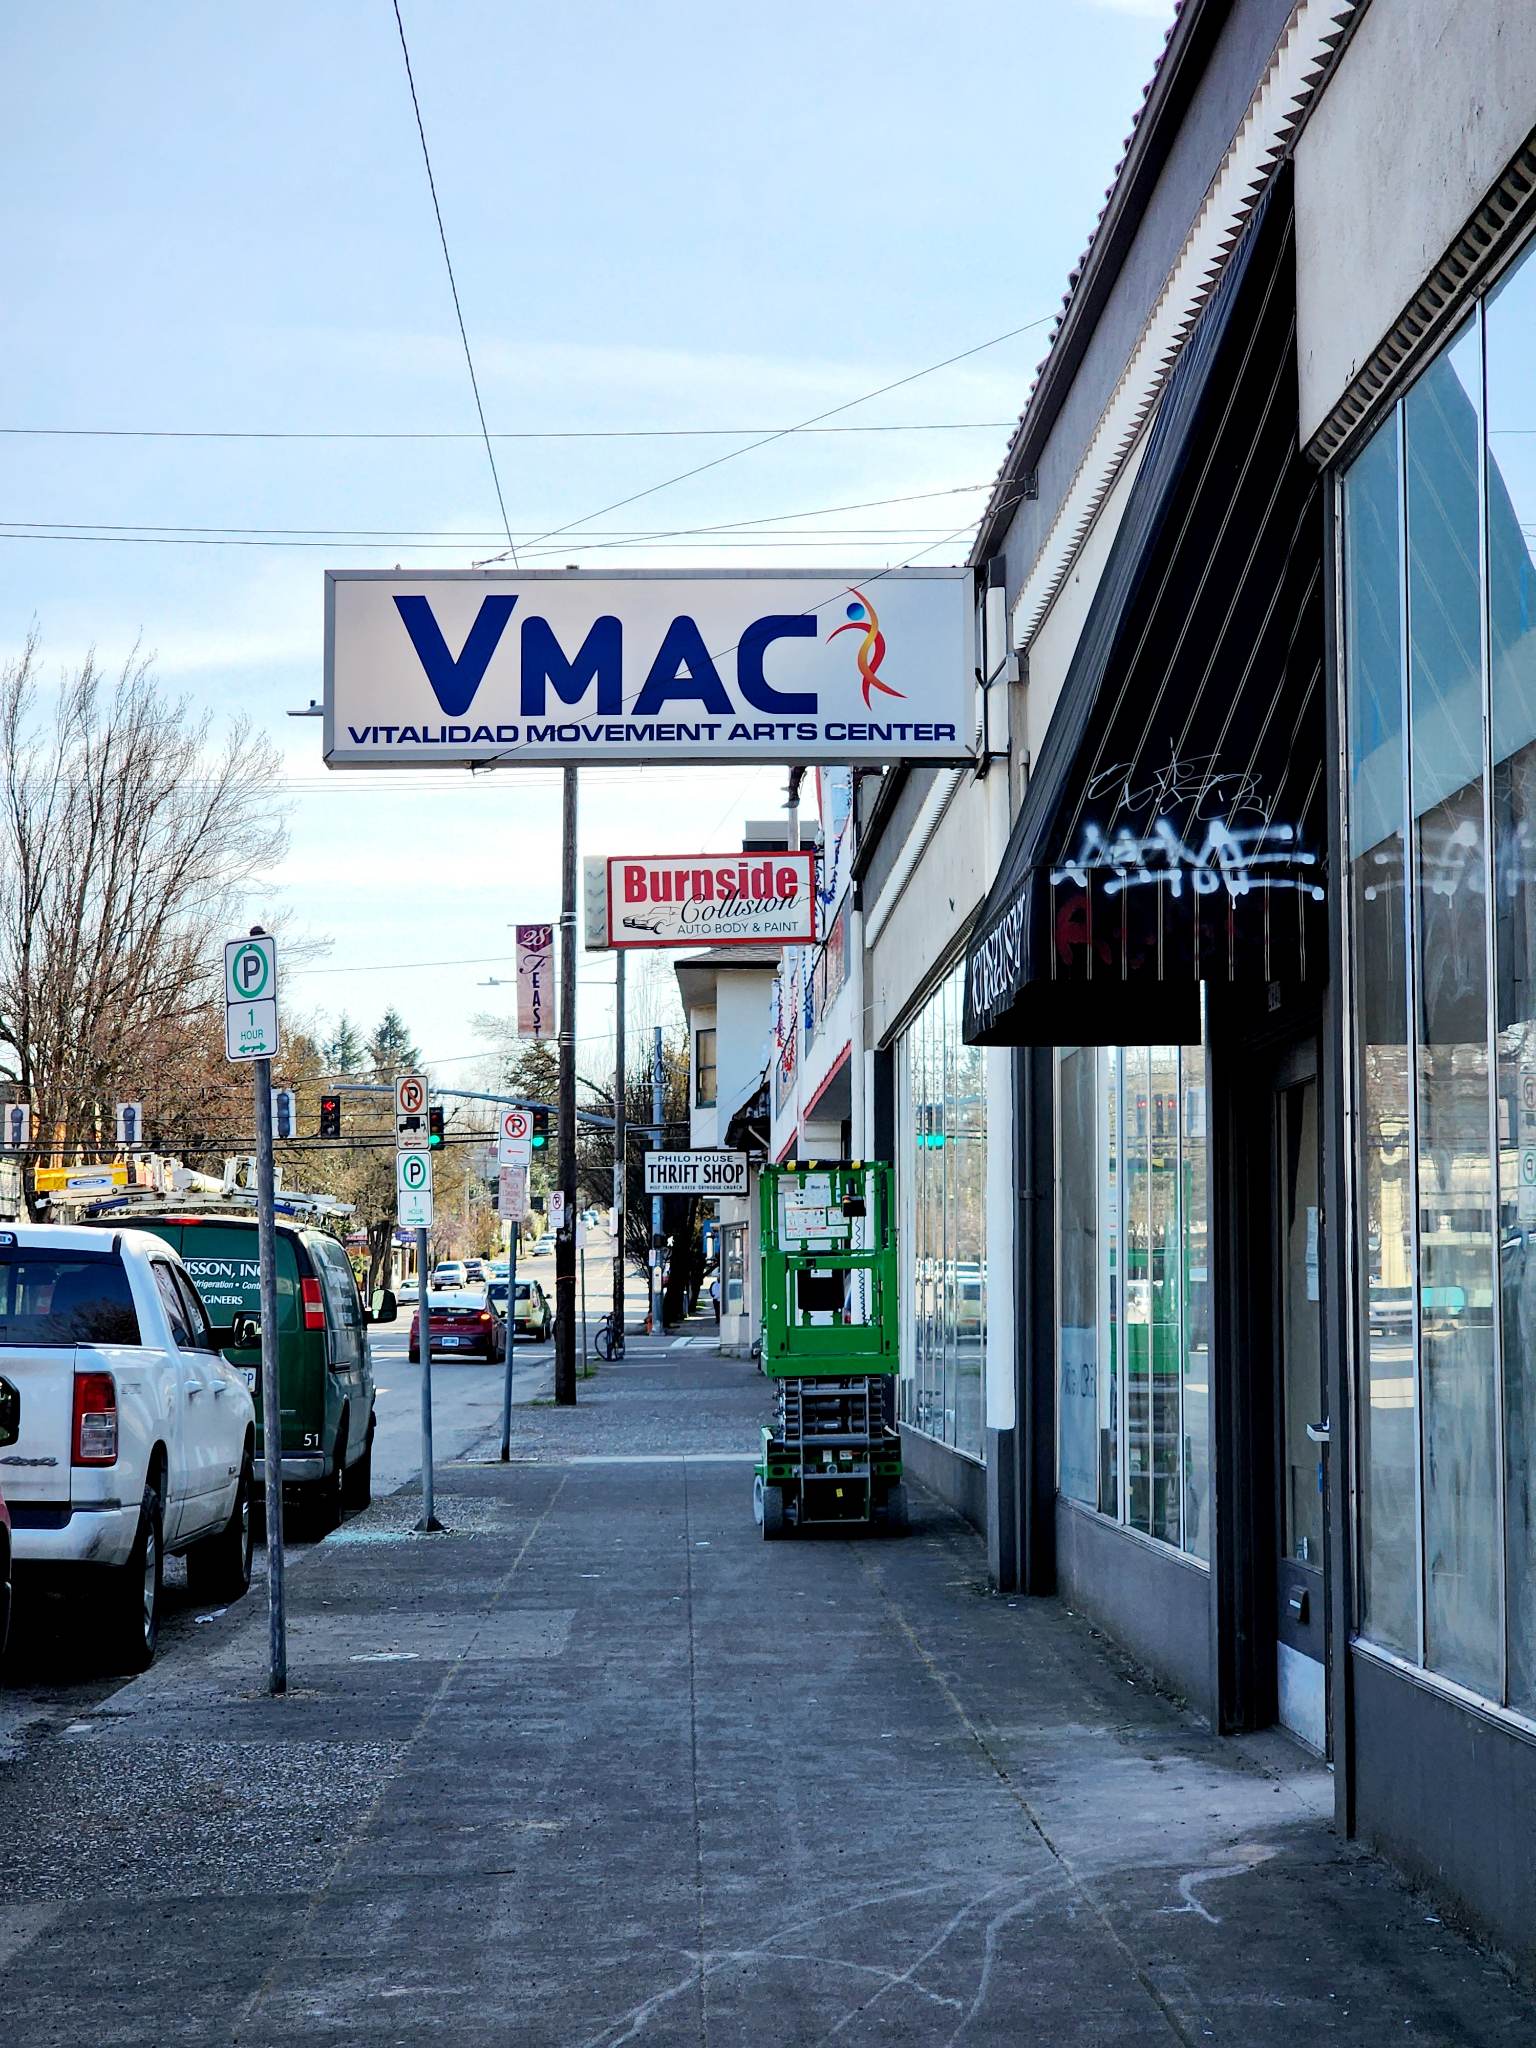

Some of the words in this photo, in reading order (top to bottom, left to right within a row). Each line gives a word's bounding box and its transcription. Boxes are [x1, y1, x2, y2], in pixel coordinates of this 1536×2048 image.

[393, 594, 818, 717] VMAC
[348, 724, 519, 744] VITALIDAD
[526, 723, 722, 744] MOVEMENT
[728, 722, 817, 742] ARTS
[825, 722, 956, 742] CENTER
[624, 862, 798, 903] Burnside
[680, 889, 797, 924] Collision
[520, 927, 551, 946] 28
[677, 924, 711, 935] AUTO
[715, 923, 747, 933] BODY
[752, 922, 760, 933] &
[765, 921, 799, 932] PAINT
[243, 955, 261, 989] P
[247, 1008, 254, 1026] 1
[240, 1029, 264, 1041] HOUR
[658, 1155, 691, 1163] PHILO
[409, 1163, 421, 1183] P
[648, 1164, 699, 1183] THRIFT
[703, 1164, 744, 1183] SHOP
[202, 1295, 243, 1305] GINEERS
[303, 1433, 319, 1447] 51
